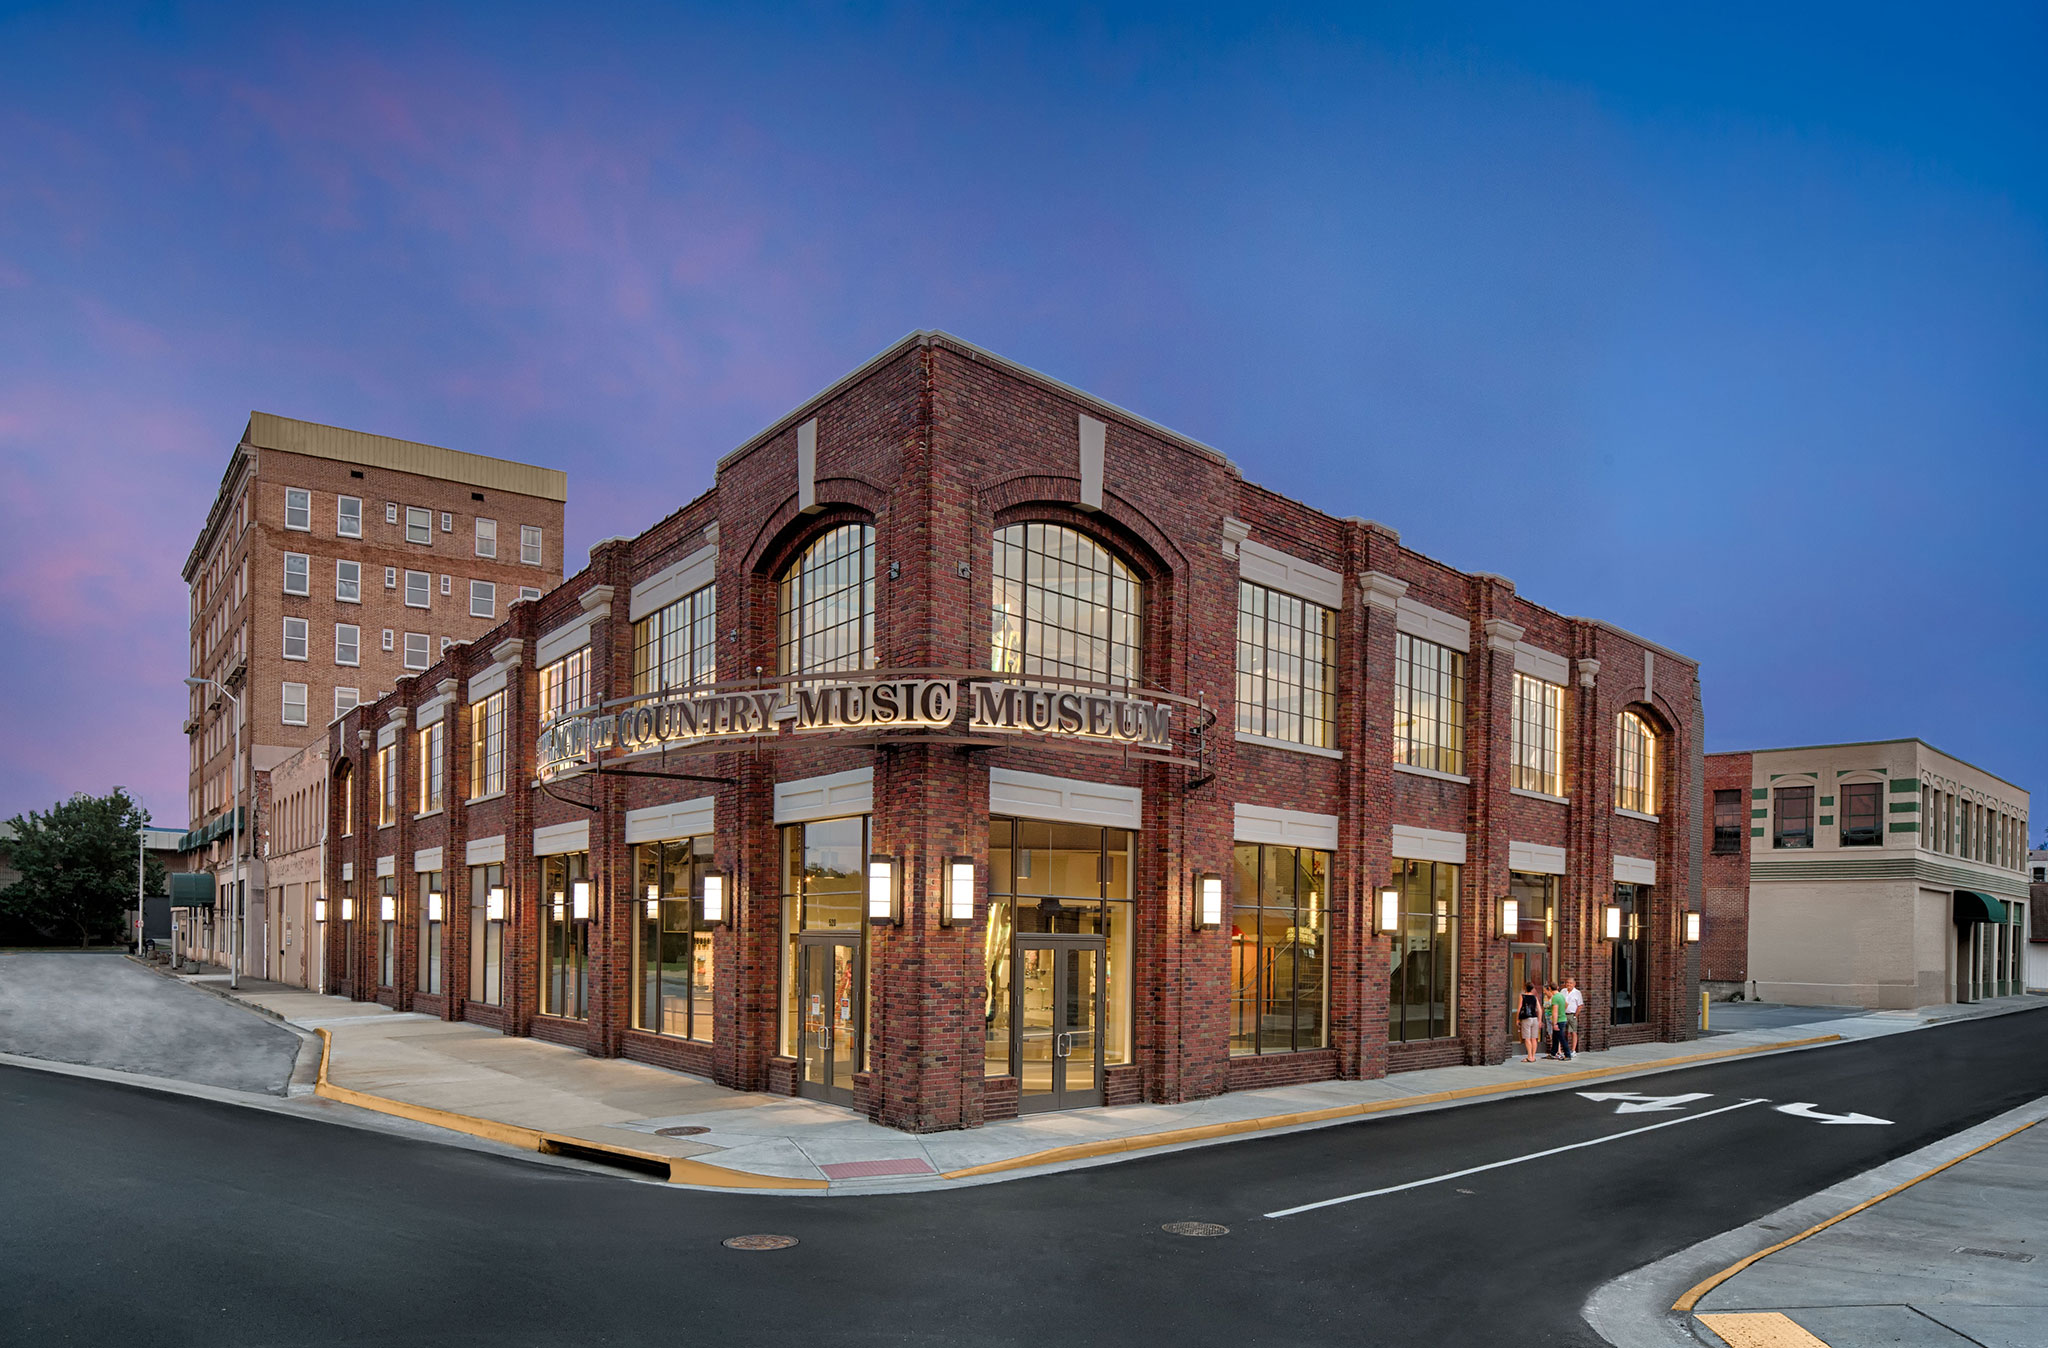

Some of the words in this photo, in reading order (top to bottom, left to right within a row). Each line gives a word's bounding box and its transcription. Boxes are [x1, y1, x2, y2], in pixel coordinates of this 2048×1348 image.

[589, 719, 616, 749] OF
[618, 692, 779, 748] COUNTRY
[796, 683, 952, 729] MUSIC
[975, 684, 1171, 744] MUSEUM
